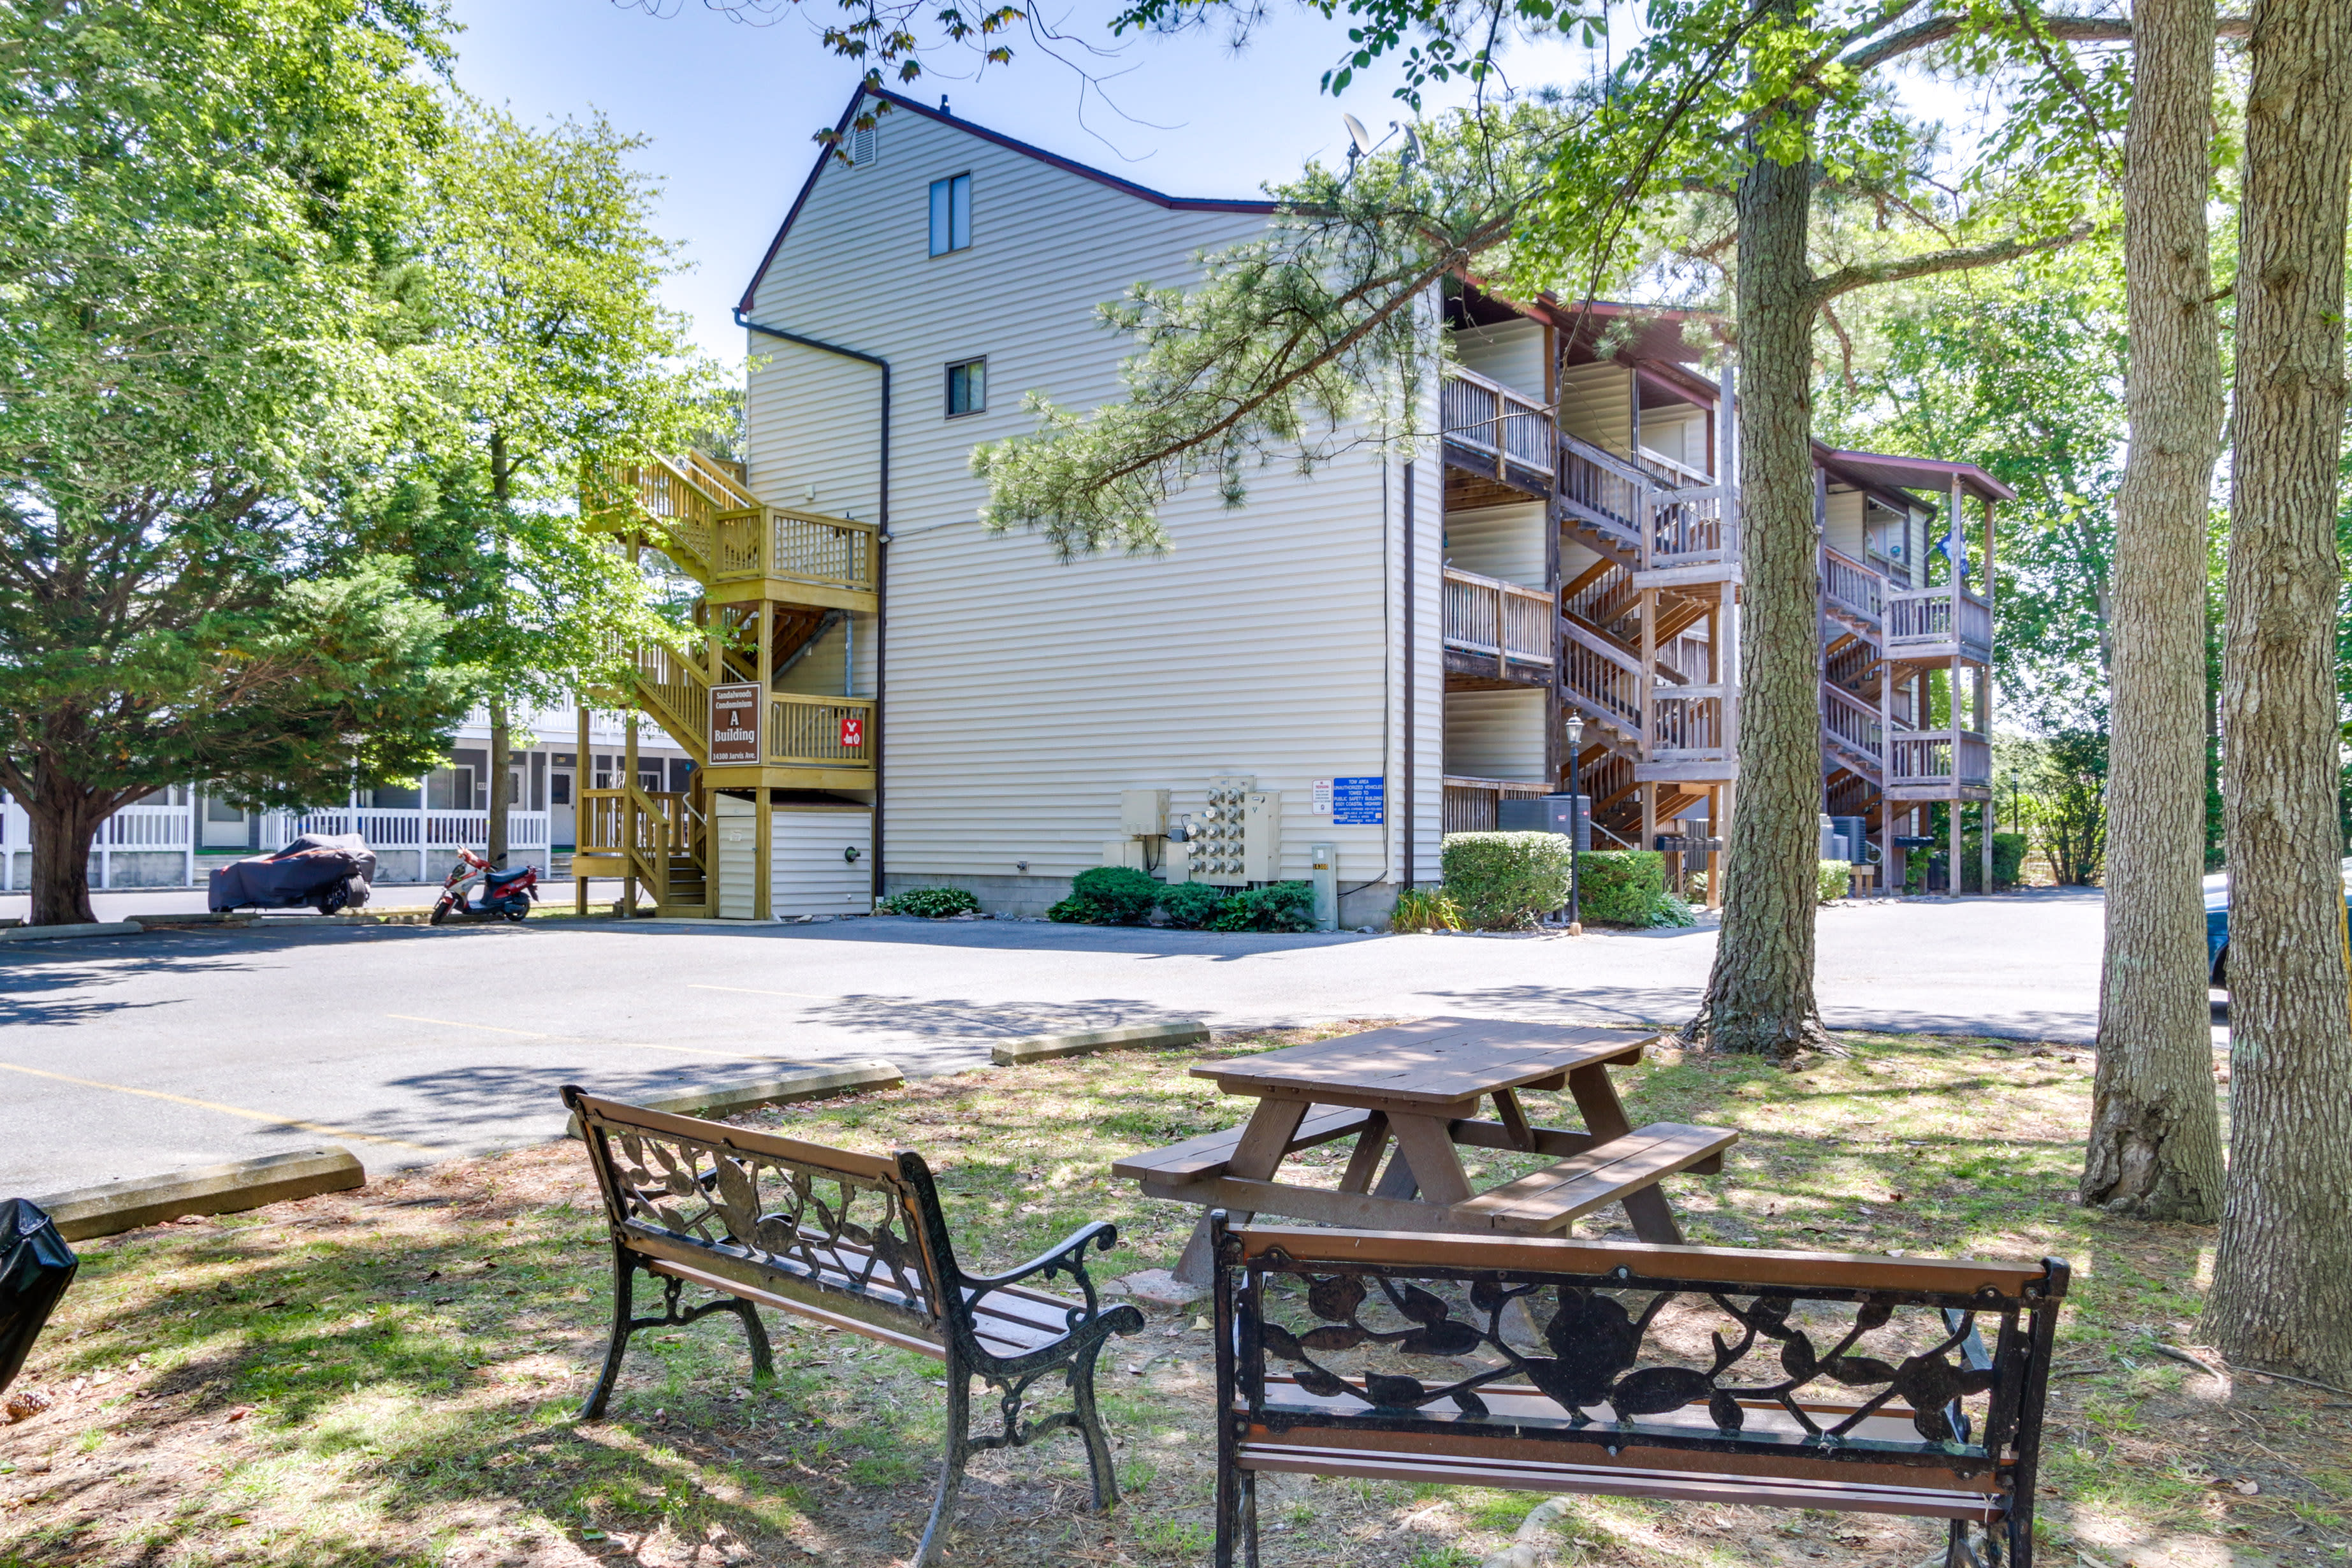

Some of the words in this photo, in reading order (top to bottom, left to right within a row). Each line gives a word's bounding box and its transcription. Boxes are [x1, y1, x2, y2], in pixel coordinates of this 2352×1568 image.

[716, 690, 752, 699] Sandalwoods
[716, 700, 753, 709] Condominium
[730, 711, 739, 725] A
[715, 728, 755, 743] Building
